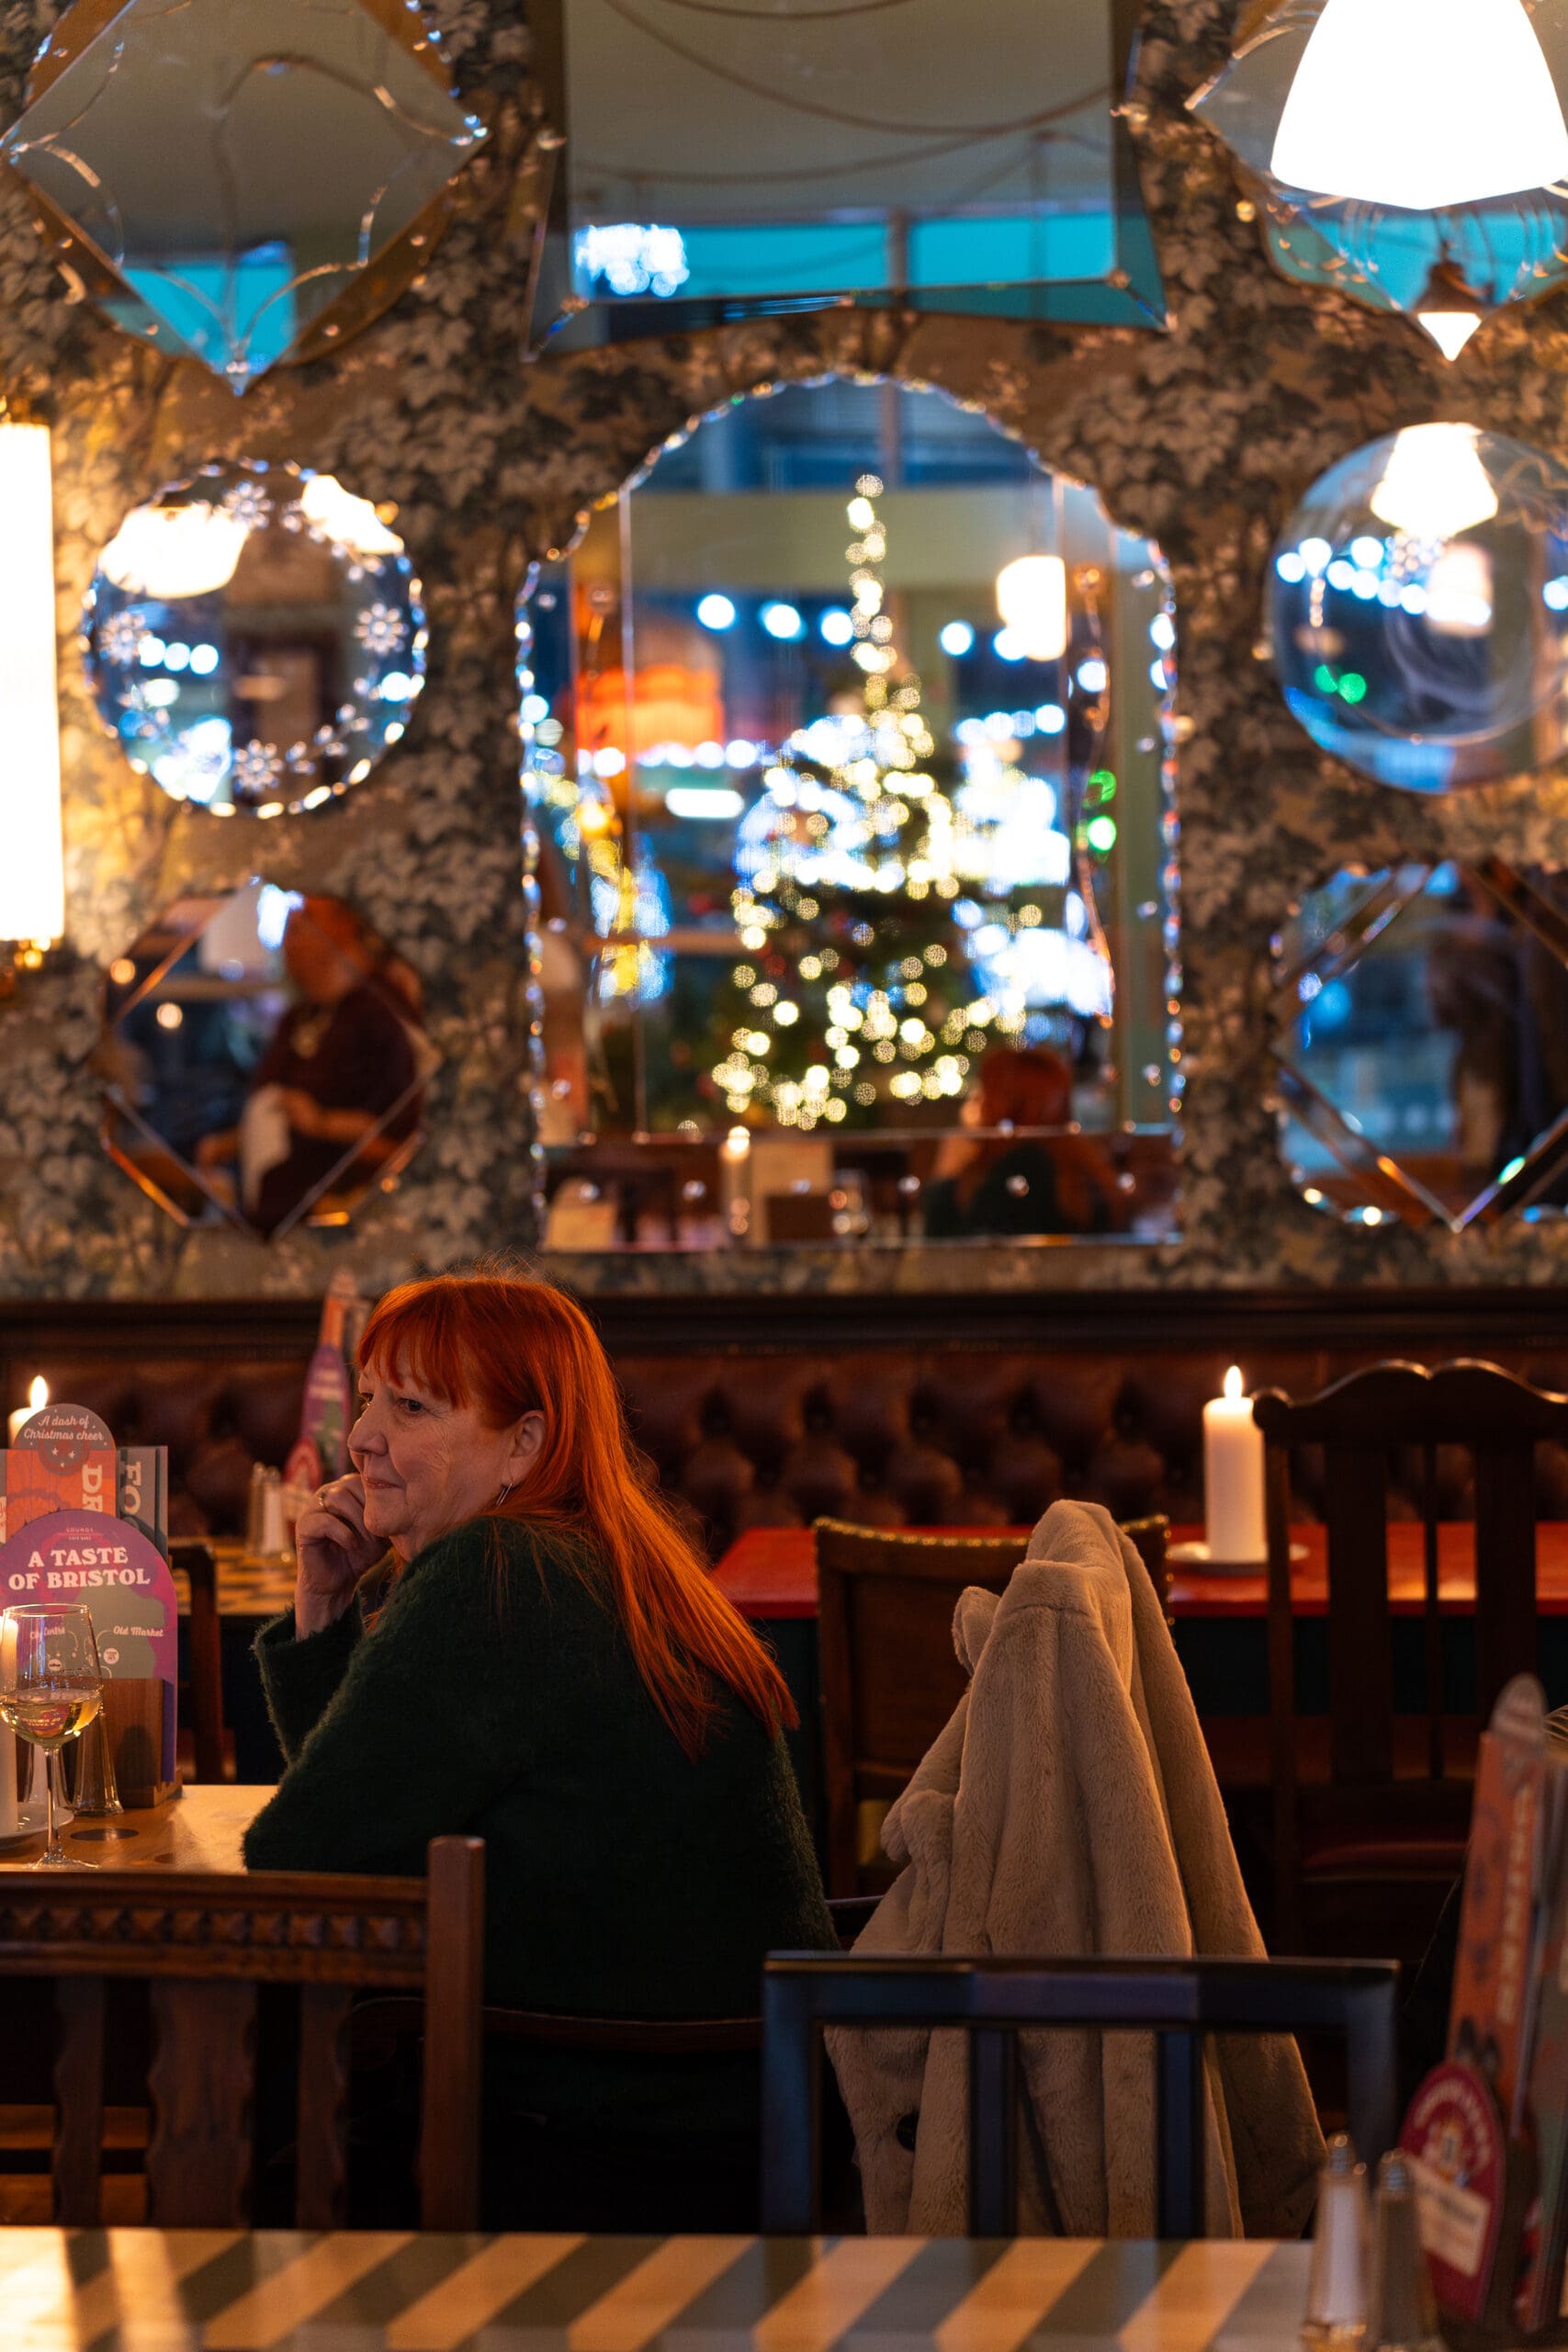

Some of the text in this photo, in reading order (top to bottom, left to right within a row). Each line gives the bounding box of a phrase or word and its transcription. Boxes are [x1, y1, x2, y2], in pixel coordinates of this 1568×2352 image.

[38, 1415, 89, 1430] A dash of
[24, 1428, 104, 1442] Christmas cheer
[28, 1546, 129, 1567] A TASTE
[8, 1568, 151, 1590] OF BRISTOL
[113, 1625, 164, 1637] Old Market
